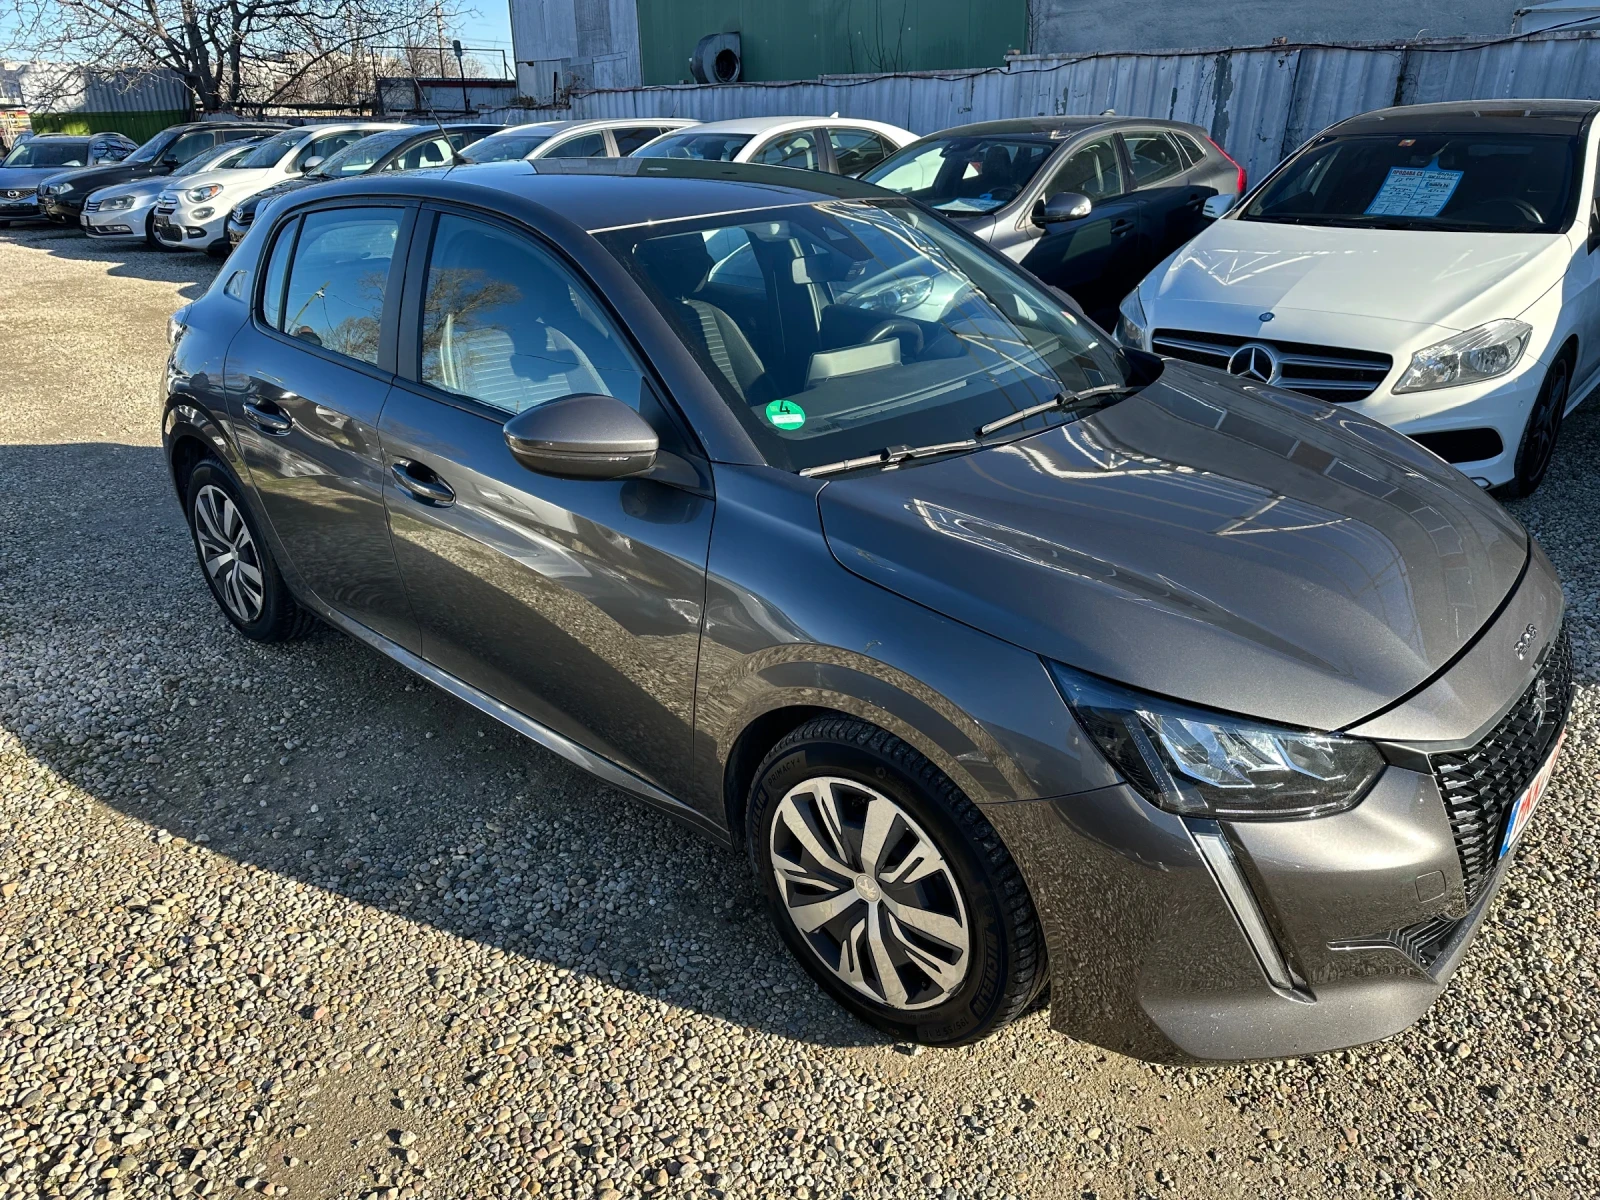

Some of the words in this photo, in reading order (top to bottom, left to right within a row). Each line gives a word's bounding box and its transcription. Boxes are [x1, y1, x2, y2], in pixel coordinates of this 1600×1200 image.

[779, 401, 790, 414] 4
[1514, 623, 1537, 660] 208
[768, 759, 796, 786] PRIMACY
[973, 930, 998, 1017] MICHELIN
[943, 1016, 969, 1036] 195/55
